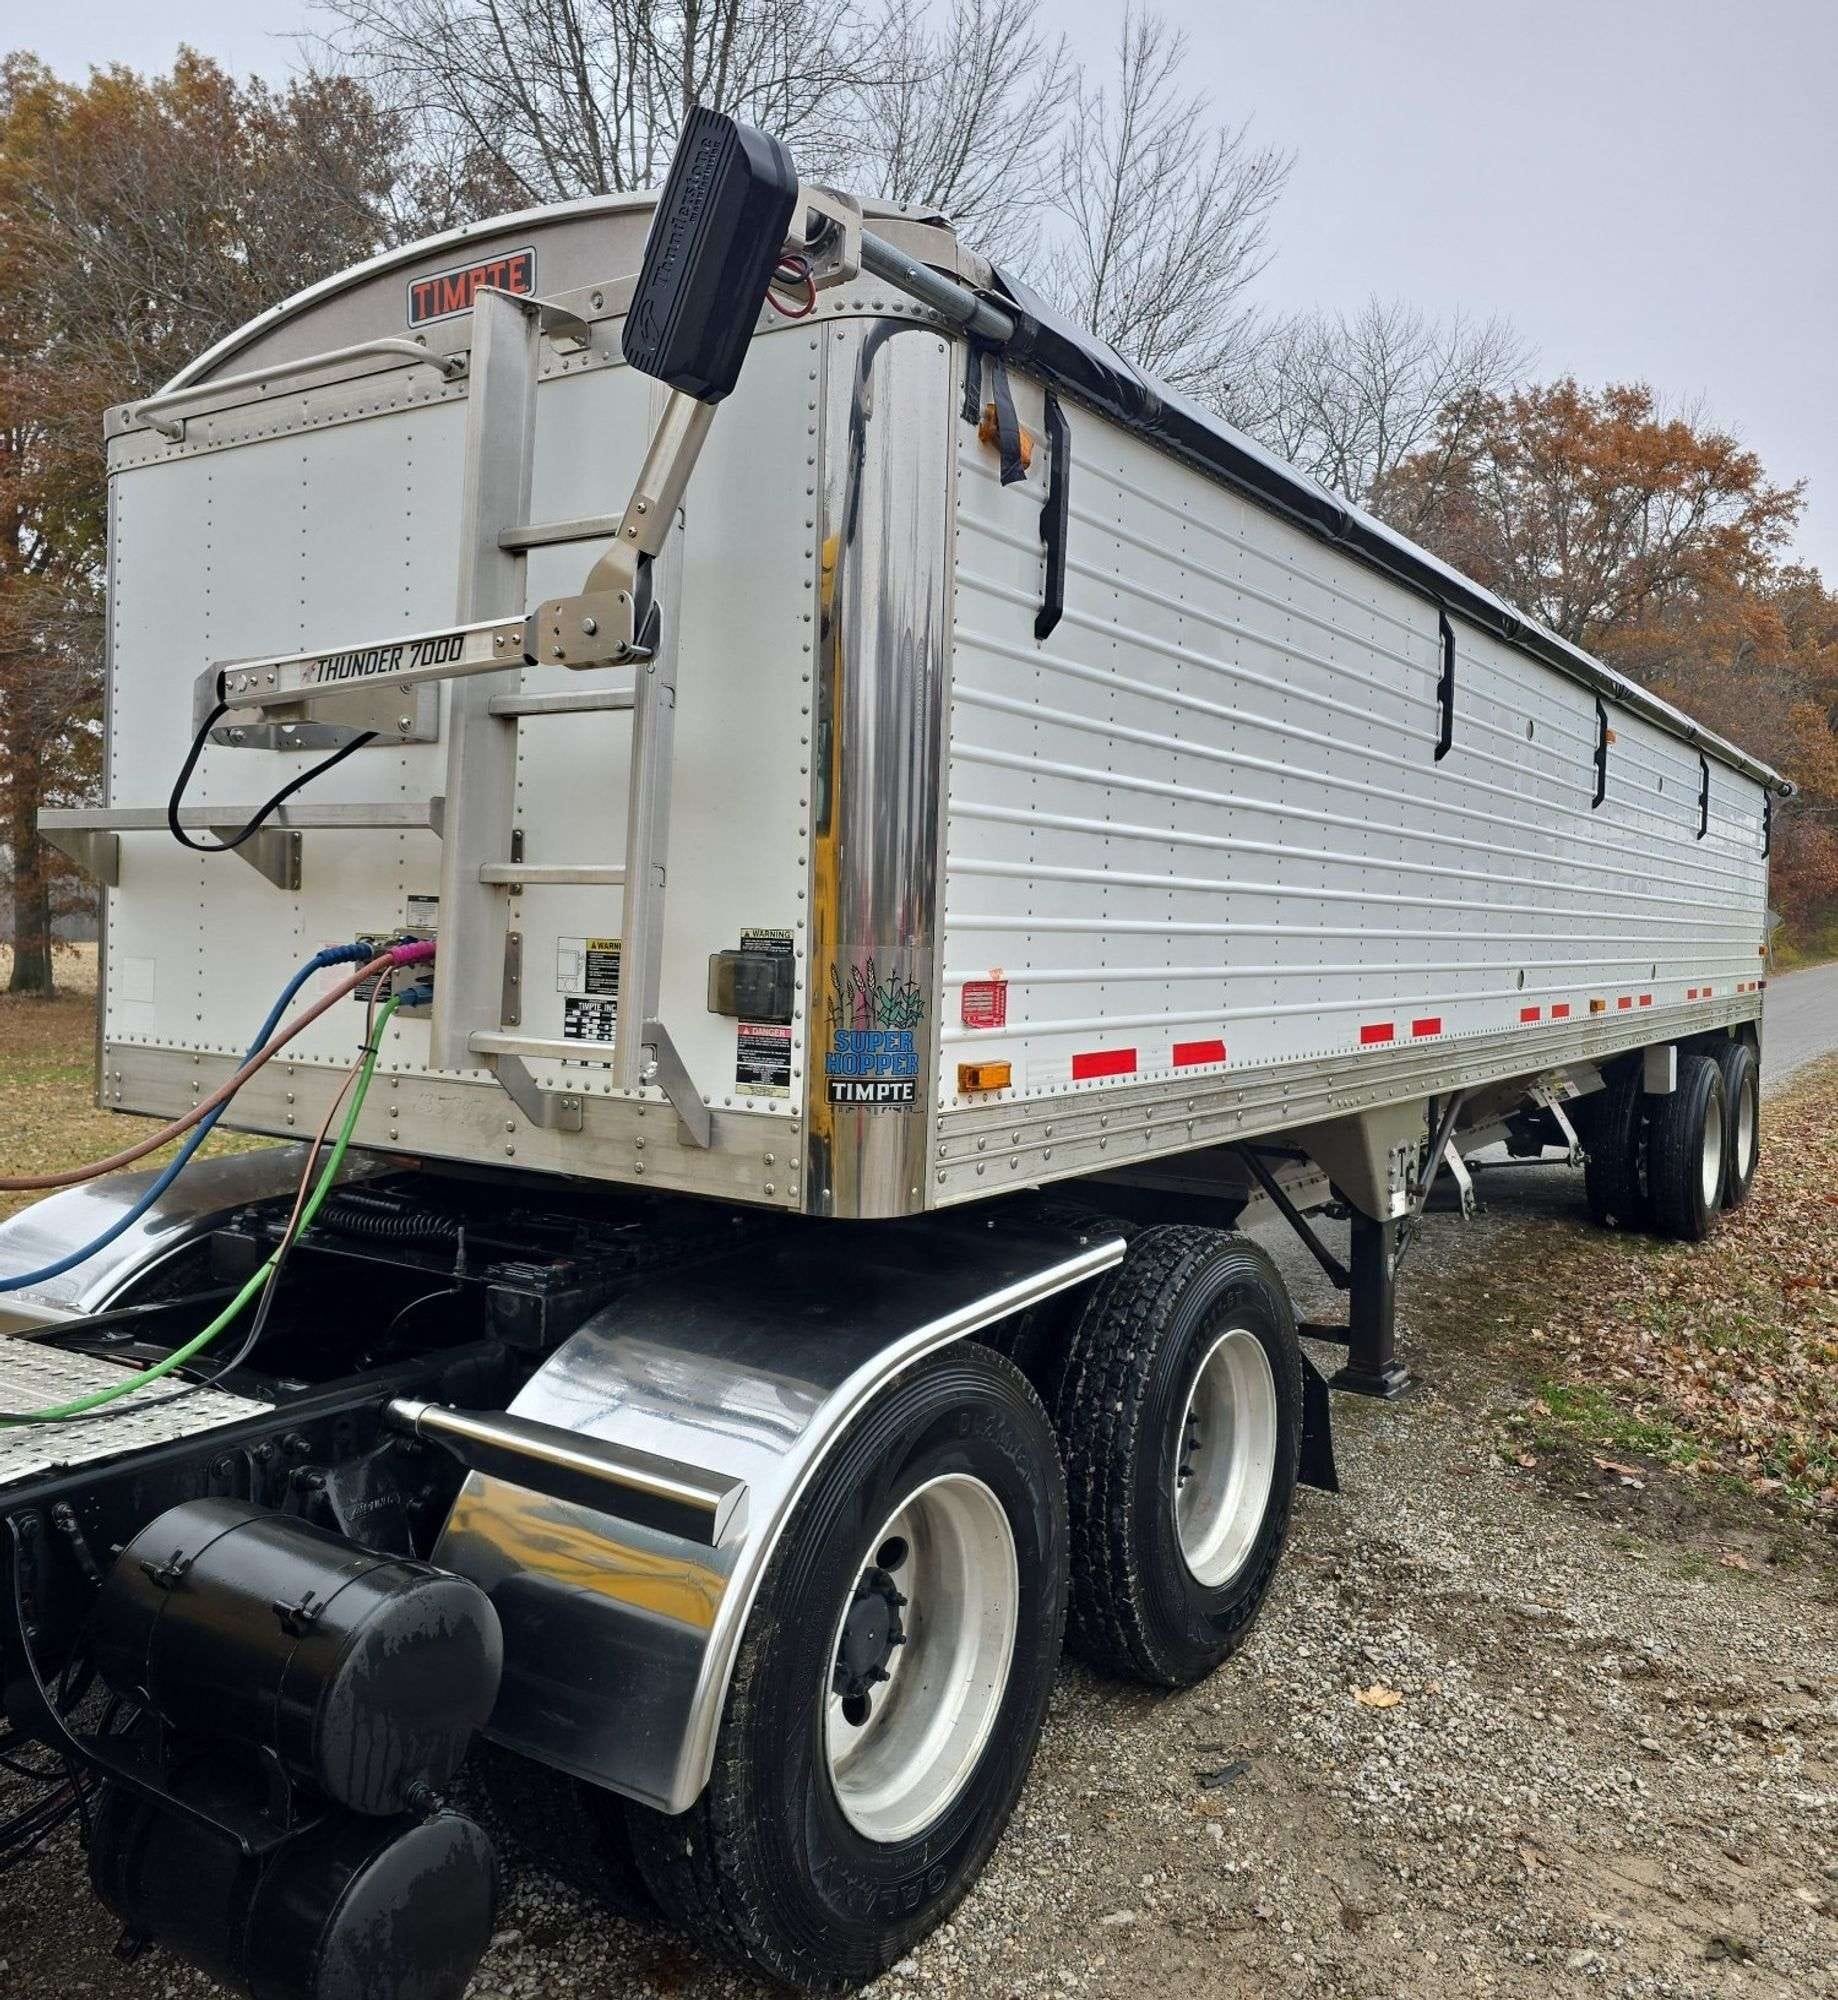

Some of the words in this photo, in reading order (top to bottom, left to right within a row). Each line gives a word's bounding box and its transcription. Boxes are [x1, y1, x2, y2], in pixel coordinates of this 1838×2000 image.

[413, 256, 529, 320] TIMPTE
[317, 647, 403, 682] THUNDER
[410, 637, 465, 668] 7000
[752, 929, 791, 938] WARNING
[597, 942, 621, 951] WARNI
[579, 1002, 602, 1011] TIMPTE
[752, 1027, 786, 1037] DANGER
[834, 1029, 914, 1052] SUPER
[825, 1052, 919, 1075] HOPPER
[832, 1083, 914, 1101] TIMPTE
